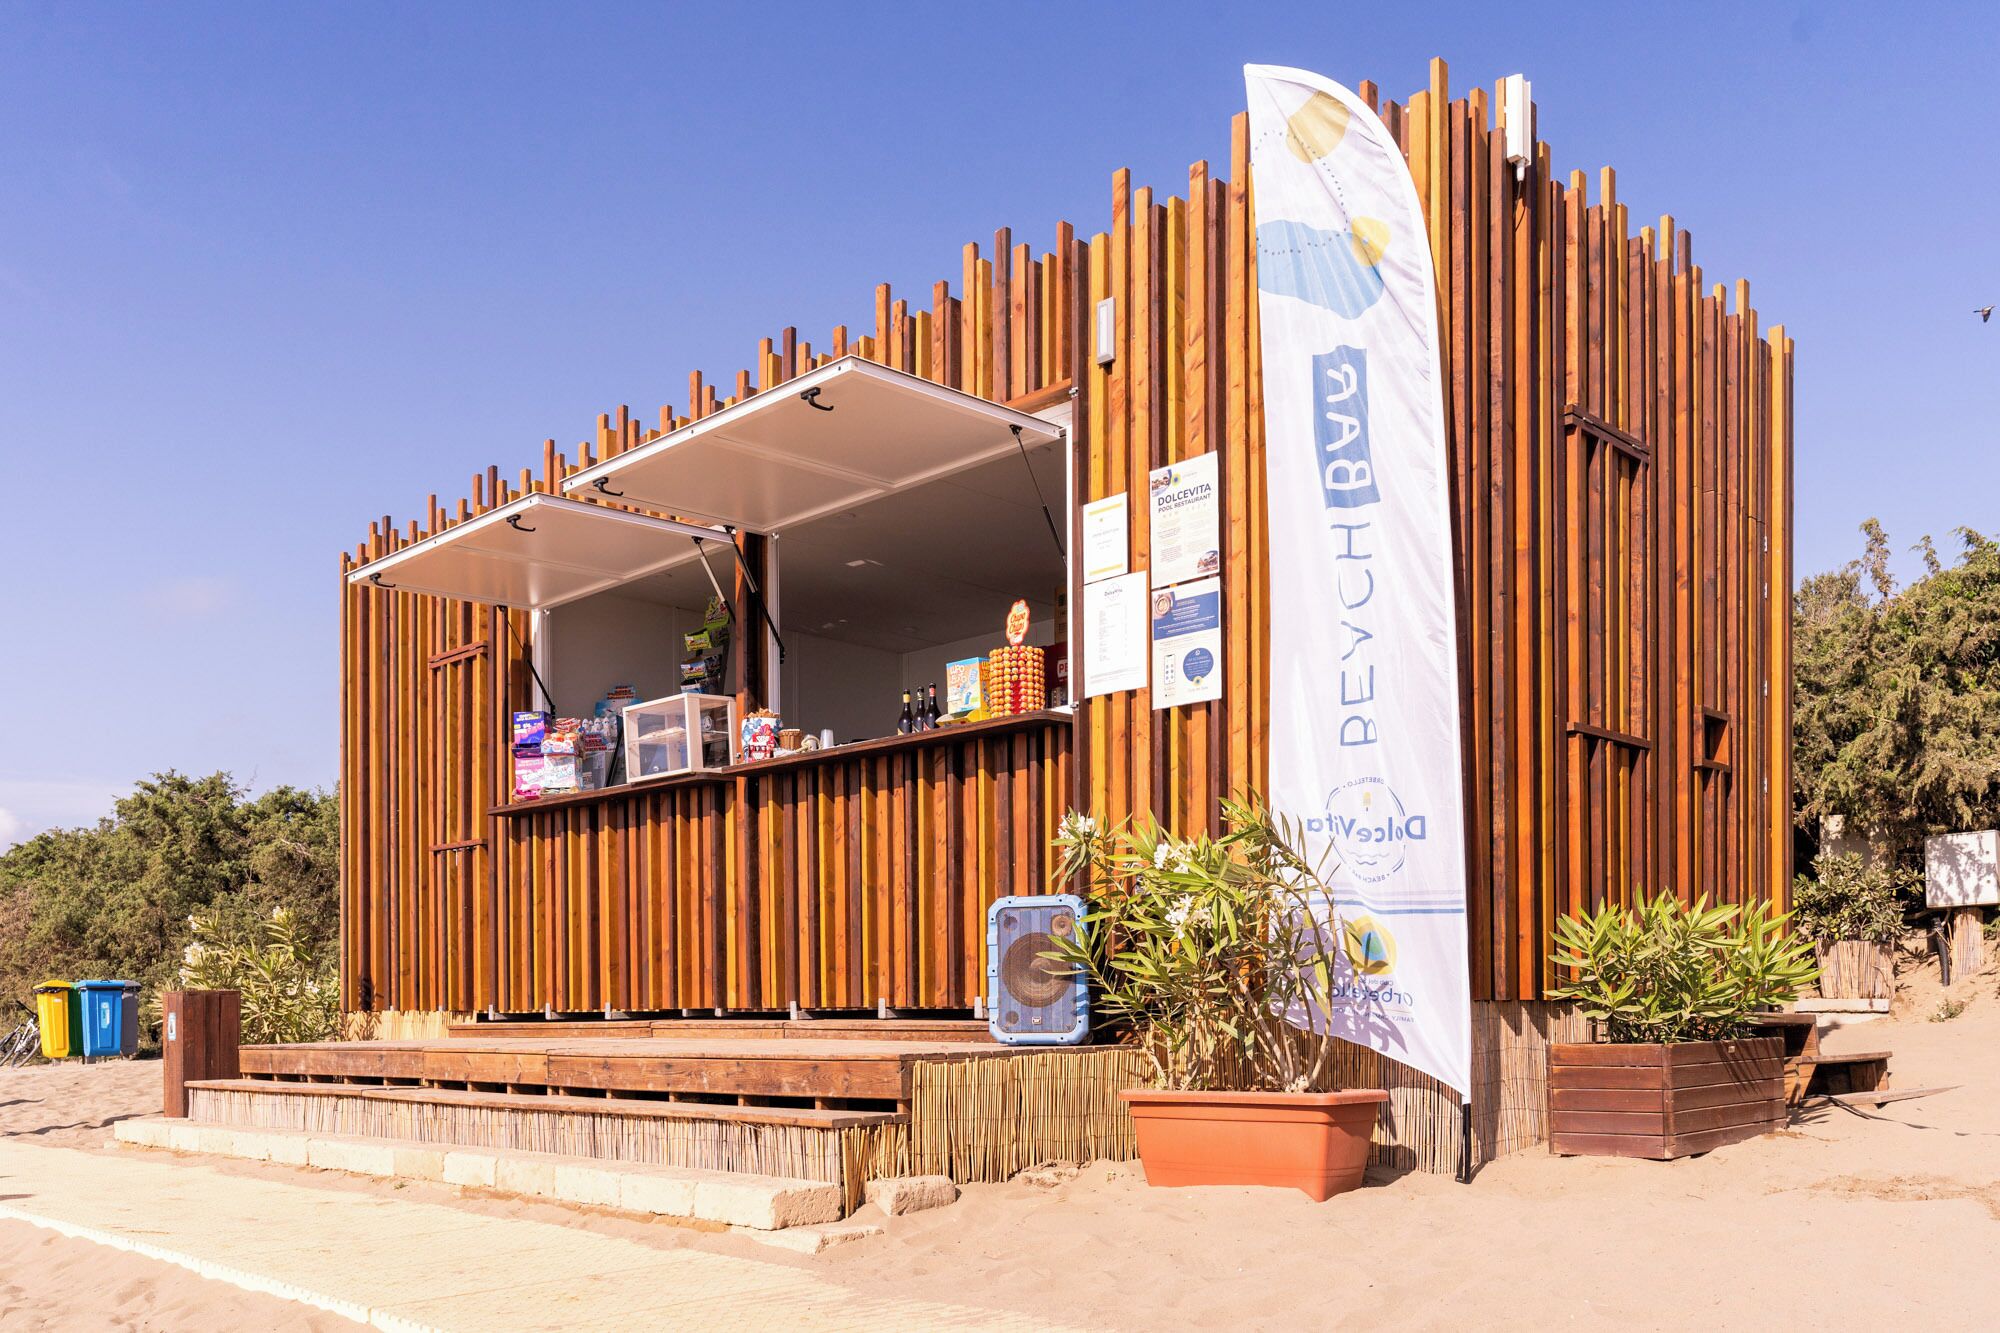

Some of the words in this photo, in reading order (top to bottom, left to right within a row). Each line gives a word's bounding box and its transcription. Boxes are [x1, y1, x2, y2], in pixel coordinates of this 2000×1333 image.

[1158, 483, 1212, 507] DOLCEVITA
[1158, 503, 1173, 514] POOL
[1174, 493, 1212, 509] RESTAURANT
[1059, 663, 1068, 674] PE
